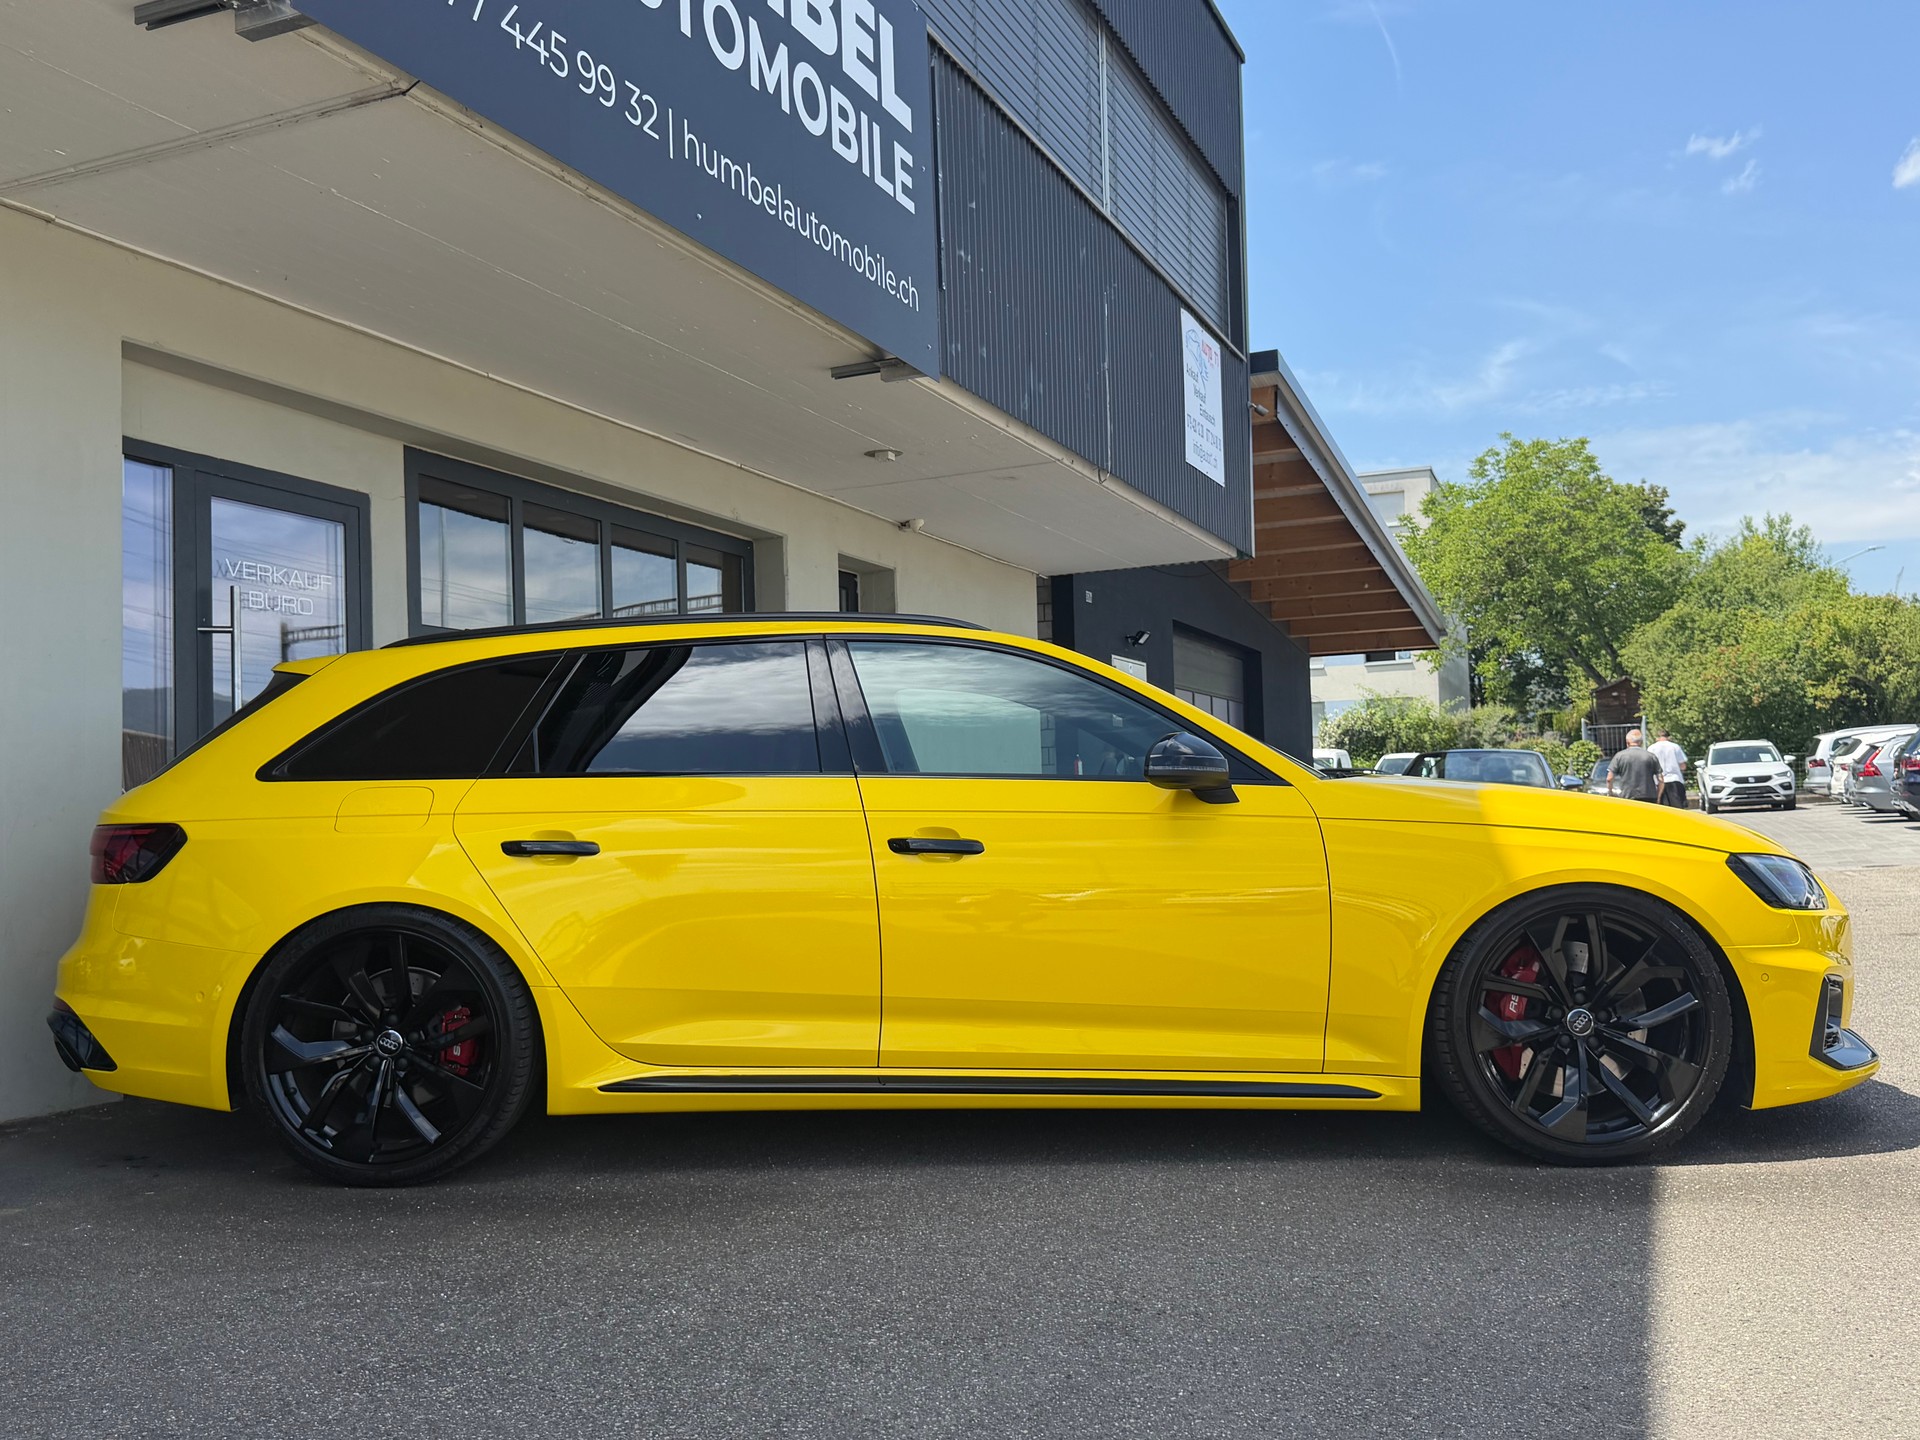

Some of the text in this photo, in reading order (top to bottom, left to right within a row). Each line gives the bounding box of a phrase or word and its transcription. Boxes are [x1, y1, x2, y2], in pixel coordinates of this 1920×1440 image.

[500, 5, 569, 77] 445
[577, 50, 616, 107] 99
[624, 80, 659, 139] 32
[684, 118, 919, 312] humbelautomobile.ch
[225, 558, 333, 590] VERKAUF
[249, 588, 314, 615] BÜRO
